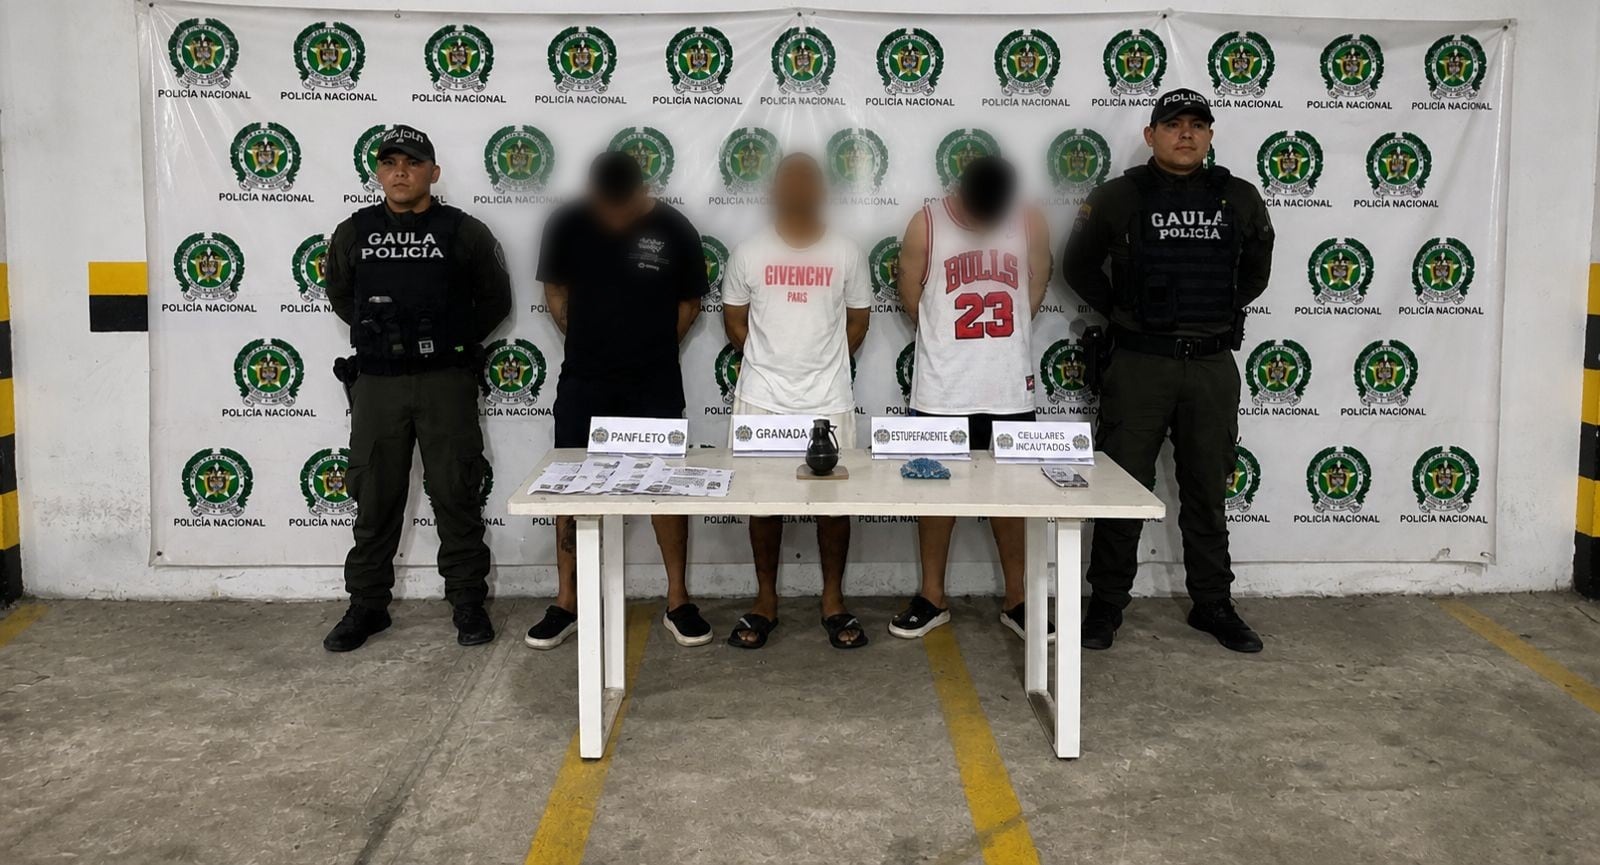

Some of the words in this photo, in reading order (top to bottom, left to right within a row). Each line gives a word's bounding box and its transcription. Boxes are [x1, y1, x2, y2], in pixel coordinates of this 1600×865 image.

[200, 90, 252, 100] NACIONAL
[280, 88, 322, 100] POLICÍA
[324, 92, 378, 102] NACIONAL
[412, 91, 453, 103] POLICÍA
[454, 94, 507, 103] NACIONAL
[576, 95, 628, 105] NACIONAL
[652, 94, 692, 105] POLICÍA
[693, 96, 743, 105] NACIONAL
[798, 97, 847, 106] NACIONAL
[905, 98, 955, 107] NACIONAL
[1021, 98, 1071, 107] NACIONAL
[1128, 98, 1159, 107] NACIO
[1208, 98, 1232, 108] LICÍA
[1234, 100, 1284, 109] NACIONAL
[1345, 101, 1393, 110] NACIONAL
[1447, 103, 1493, 112] NACIONAL
[261, 194, 315, 203] NACIONAL
[1283, 199, 1333, 208] NACIONAL
[1353, 196, 1391, 208] POLICÍA
[1392, 199, 1439, 208] NACIONAL
[1151, 210, 1223, 227] GAULA
[1159, 226, 1221, 240] POLICÍA
[367, 232, 437, 245] GAULA
[361, 244, 444, 260] POLICÍA
[765, 264, 834, 287] GIVENCHY
[944, 248, 1019, 295] BULLS
[787, 291, 808, 304] PARIS
[161, 302, 203, 313] POLICÍA
[205, 304, 257, 313] NACIONAL
[700, 305, 724, 314] ACIO
[1039, 304, 1065, 313] ONAL
[1243, 306, 1272, 315] ONAL
[1333, 307, 1382, 316] NACIONAL
[1436, 306, 1485, 315] NACIONAL
[954, 291, 1015, 340] 23
[264, 409, 317, 418] NACIONAL
[478, 406, 504, 416] LICÍA
[505, 407, 554, 417] NACIONA
[704, 407, 732, 415] POLIC
[1035, 405, 1067, 415] OLICÍA
[1068, 407, 1098, 415] NACIO
[1238, 404, 1270, 416] OLICÍA
[1271, 408, 1320, 416] NACIONAL
[1378, 408, 1427, 416] NACIONAL
[610, 431, 666, 444] PANFLETO
[755, 428, 808, 439] GRANADA
[891, 430, 949, 442] ESTUPEFACIENTE
[1017, 431, 1065, 441] CELULARES
[1015, 443, 1071, 453] INCAUTADOS
[173, 516, 211, 527] POLICÍA
[213, 518, 266, 528] NACIONAL
[288, 516, 329, 527] POLICÍA
[330, 518, 355, 527] NACI
[1226, 514, 1271, 523] ACIONAL
[1332, 515, 1381, 524] NACIONAL
[1438, 515, 1489, 525] NACIONAL
